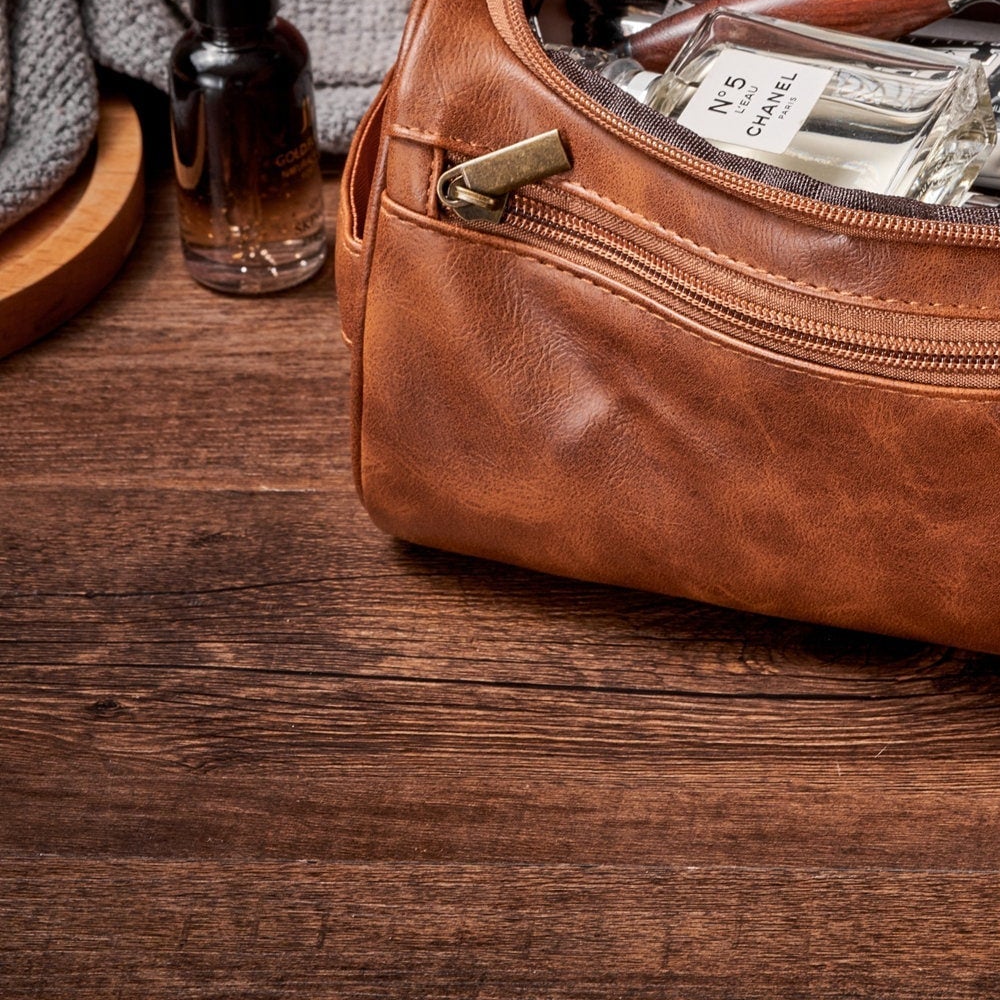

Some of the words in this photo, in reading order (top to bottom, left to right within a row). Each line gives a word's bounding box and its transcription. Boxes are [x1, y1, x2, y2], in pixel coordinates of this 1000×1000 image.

[734, 85, 758, 114] L'EAU
[746, 73, 798, 137] CHANEL
[778, 96, 797, 120] PARIS
